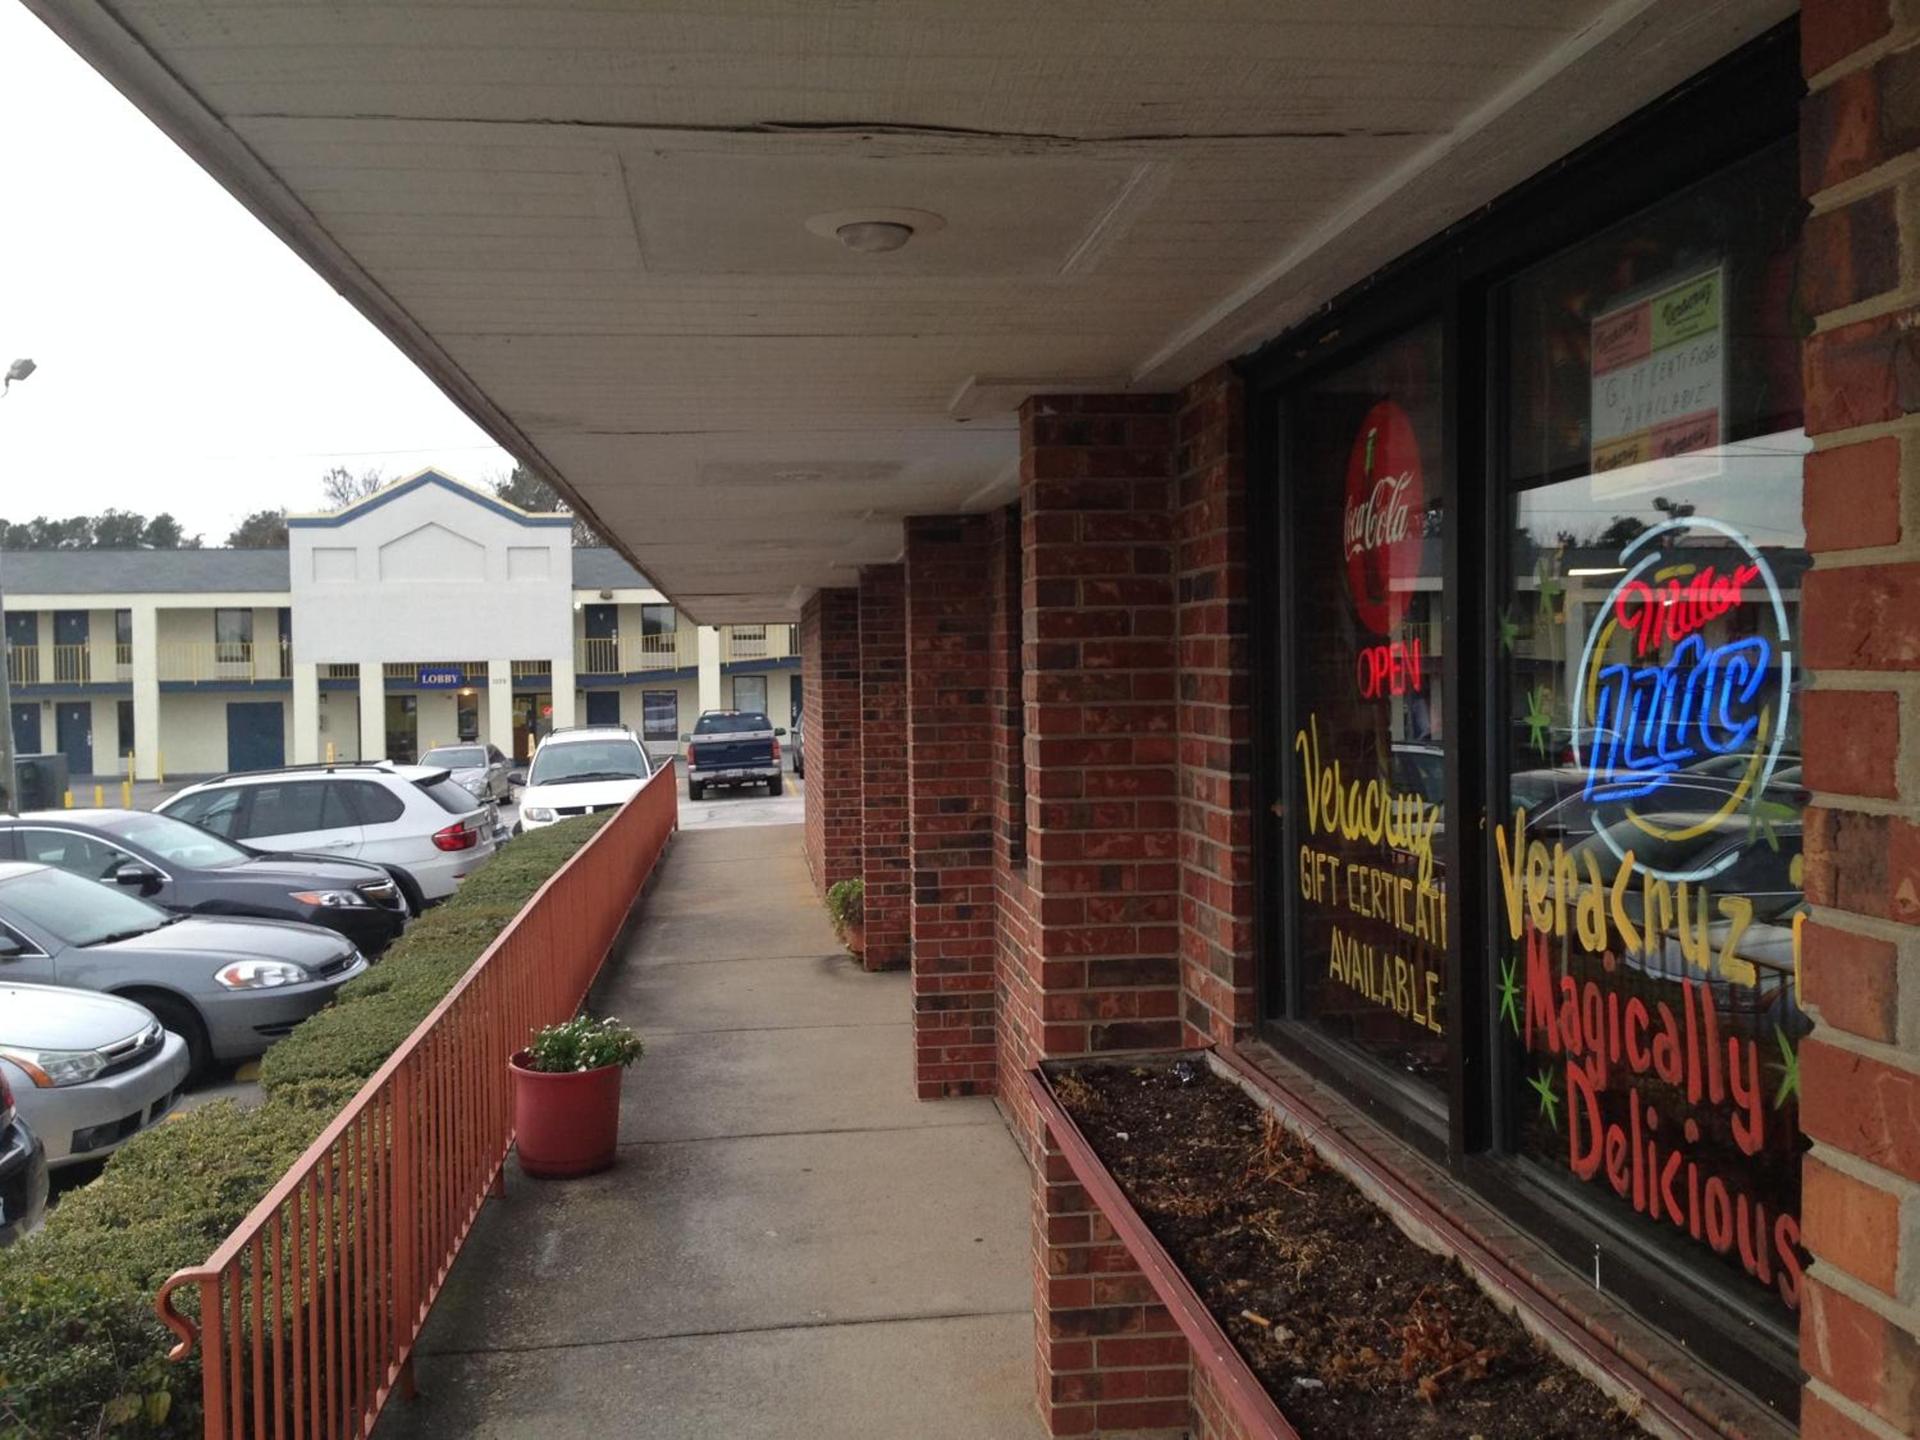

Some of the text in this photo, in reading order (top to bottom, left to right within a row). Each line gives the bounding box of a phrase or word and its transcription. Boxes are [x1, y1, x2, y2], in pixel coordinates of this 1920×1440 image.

[421, 673, 459, 684] LOBBY
[1358, 638, 1421, 698] OPEN
[1614, 564, 1761, 658] Miller
[1583, 633, 1770, 802] Lite
[1295, 712, 1440, 890] Veracruz
[1301, 844, 1340, 906] GIFT
[1495, 806, 1757, 988] Veracruz
[1329, 924, 1442, 1035] AVAILABLE
[1525, 916, 1764, 1157] Magically
[1566, 1059, 1802, 1311] Delicious
